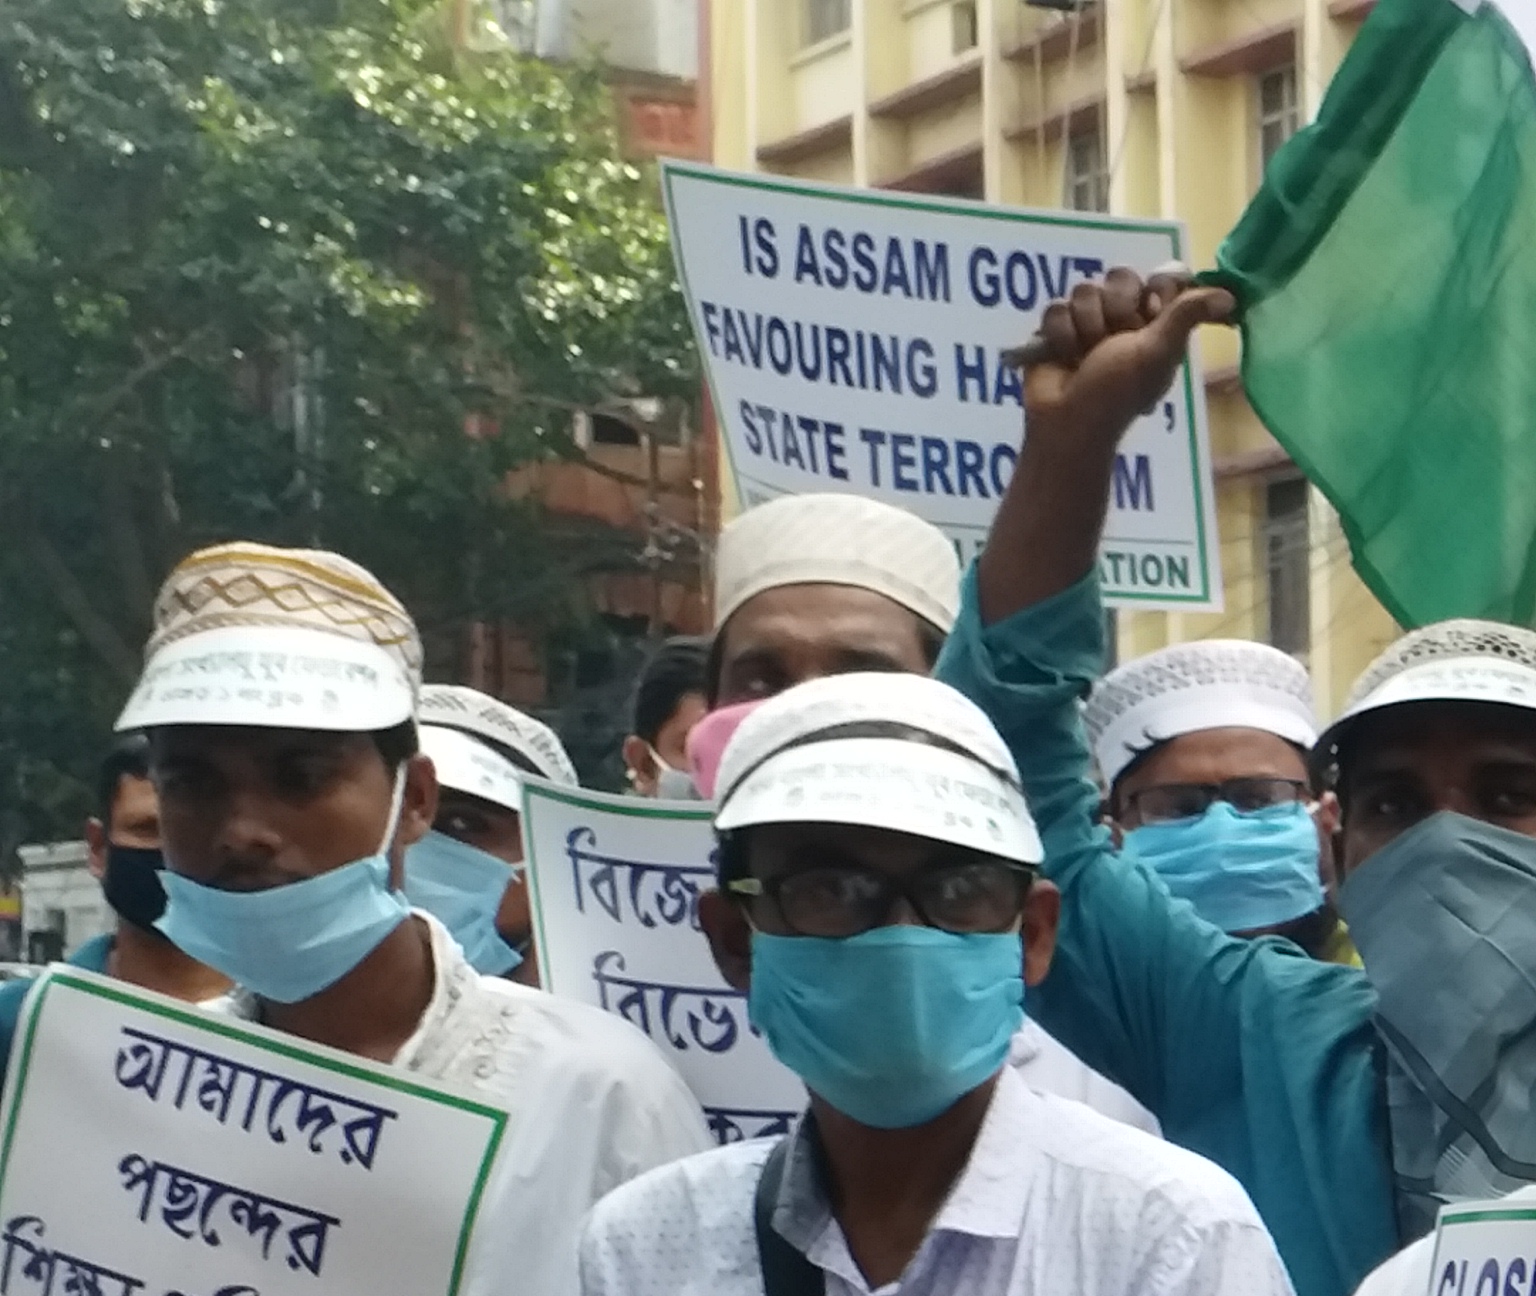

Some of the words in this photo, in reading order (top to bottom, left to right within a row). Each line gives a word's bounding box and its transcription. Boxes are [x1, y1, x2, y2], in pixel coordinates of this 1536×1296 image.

[739, 214, 778, 278] IS
[794, 227, 949, 303] ASSAM
[701, 301, 938, 398] FAVOURING
[737, 400, 849, 480] STATE
[859, 428, 1155, 512] TERROM
[115, 1027, 397, 1171] আমাদের
[117, 1152, 341, 1275] পছন্দের
